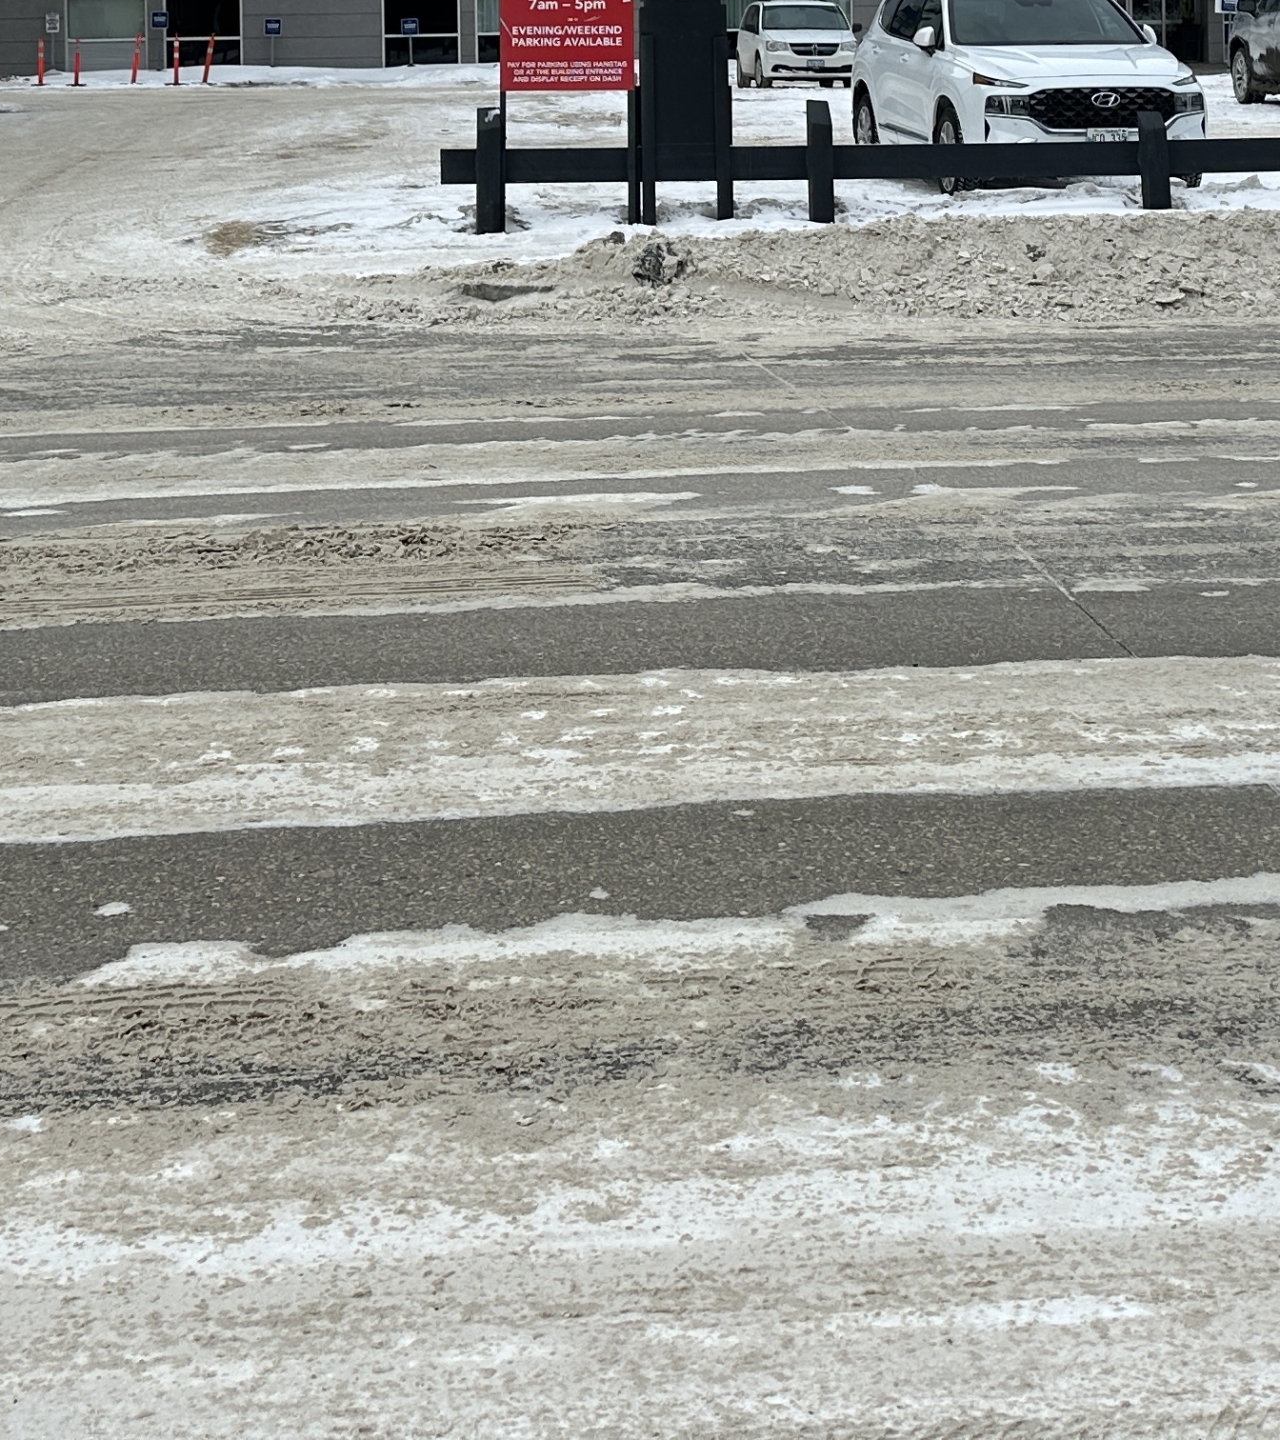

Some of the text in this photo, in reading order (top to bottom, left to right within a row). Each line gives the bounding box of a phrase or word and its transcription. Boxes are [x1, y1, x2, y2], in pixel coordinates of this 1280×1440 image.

[512, 26, 622, 35] EVENING/WEEKEND
[512, 37, 622, 47] PARKING AVAILABLE
